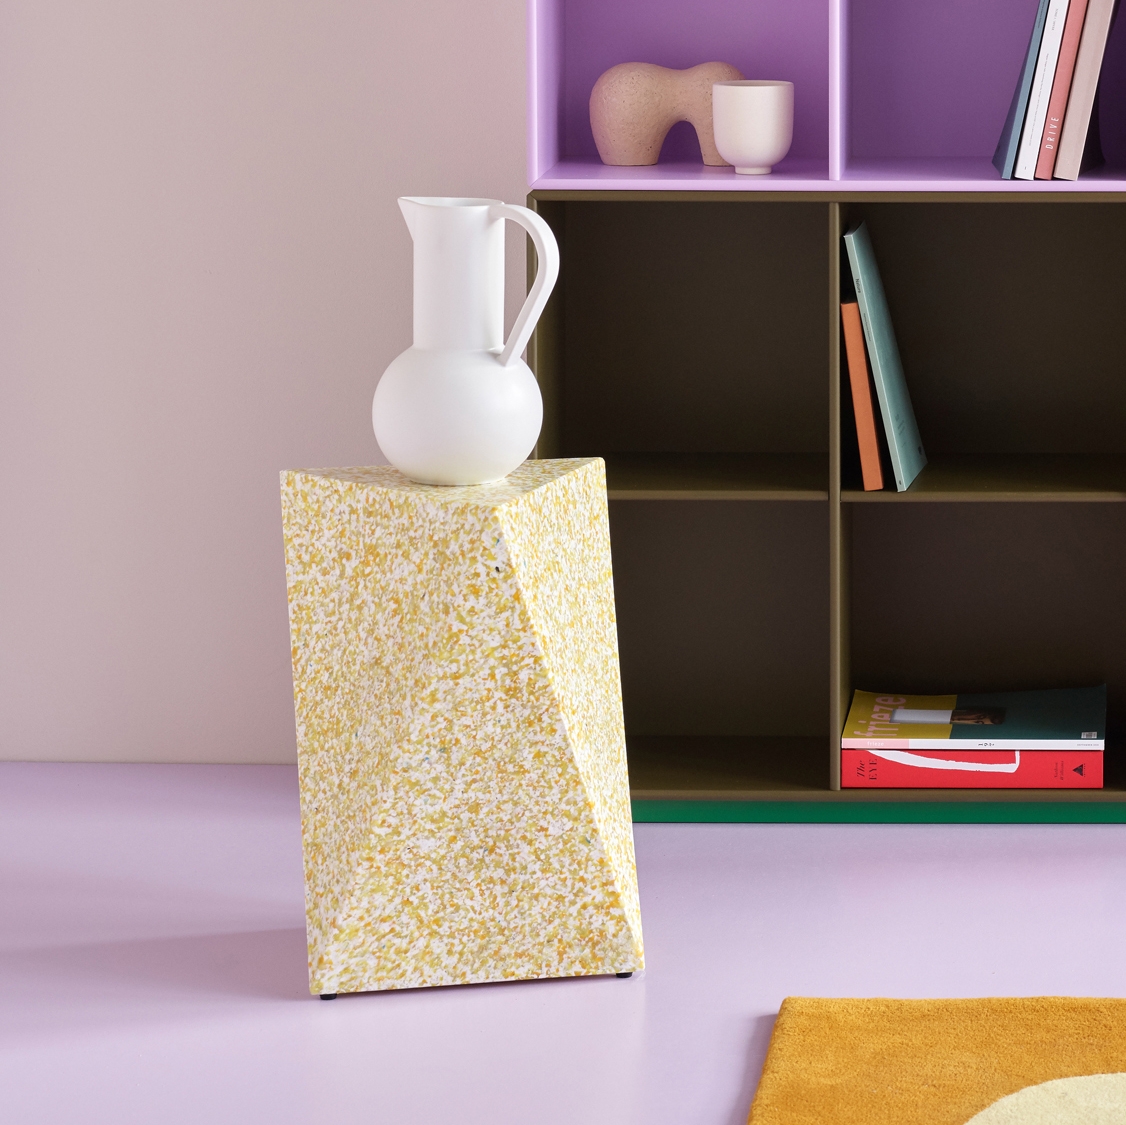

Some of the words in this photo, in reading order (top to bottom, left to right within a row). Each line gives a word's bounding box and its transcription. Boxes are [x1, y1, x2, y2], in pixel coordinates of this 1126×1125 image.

[1045, 117, 1059, 150] DRIVE
[853, 696, 906, 737] frieze
[868, 758, 878, 781] EYE
